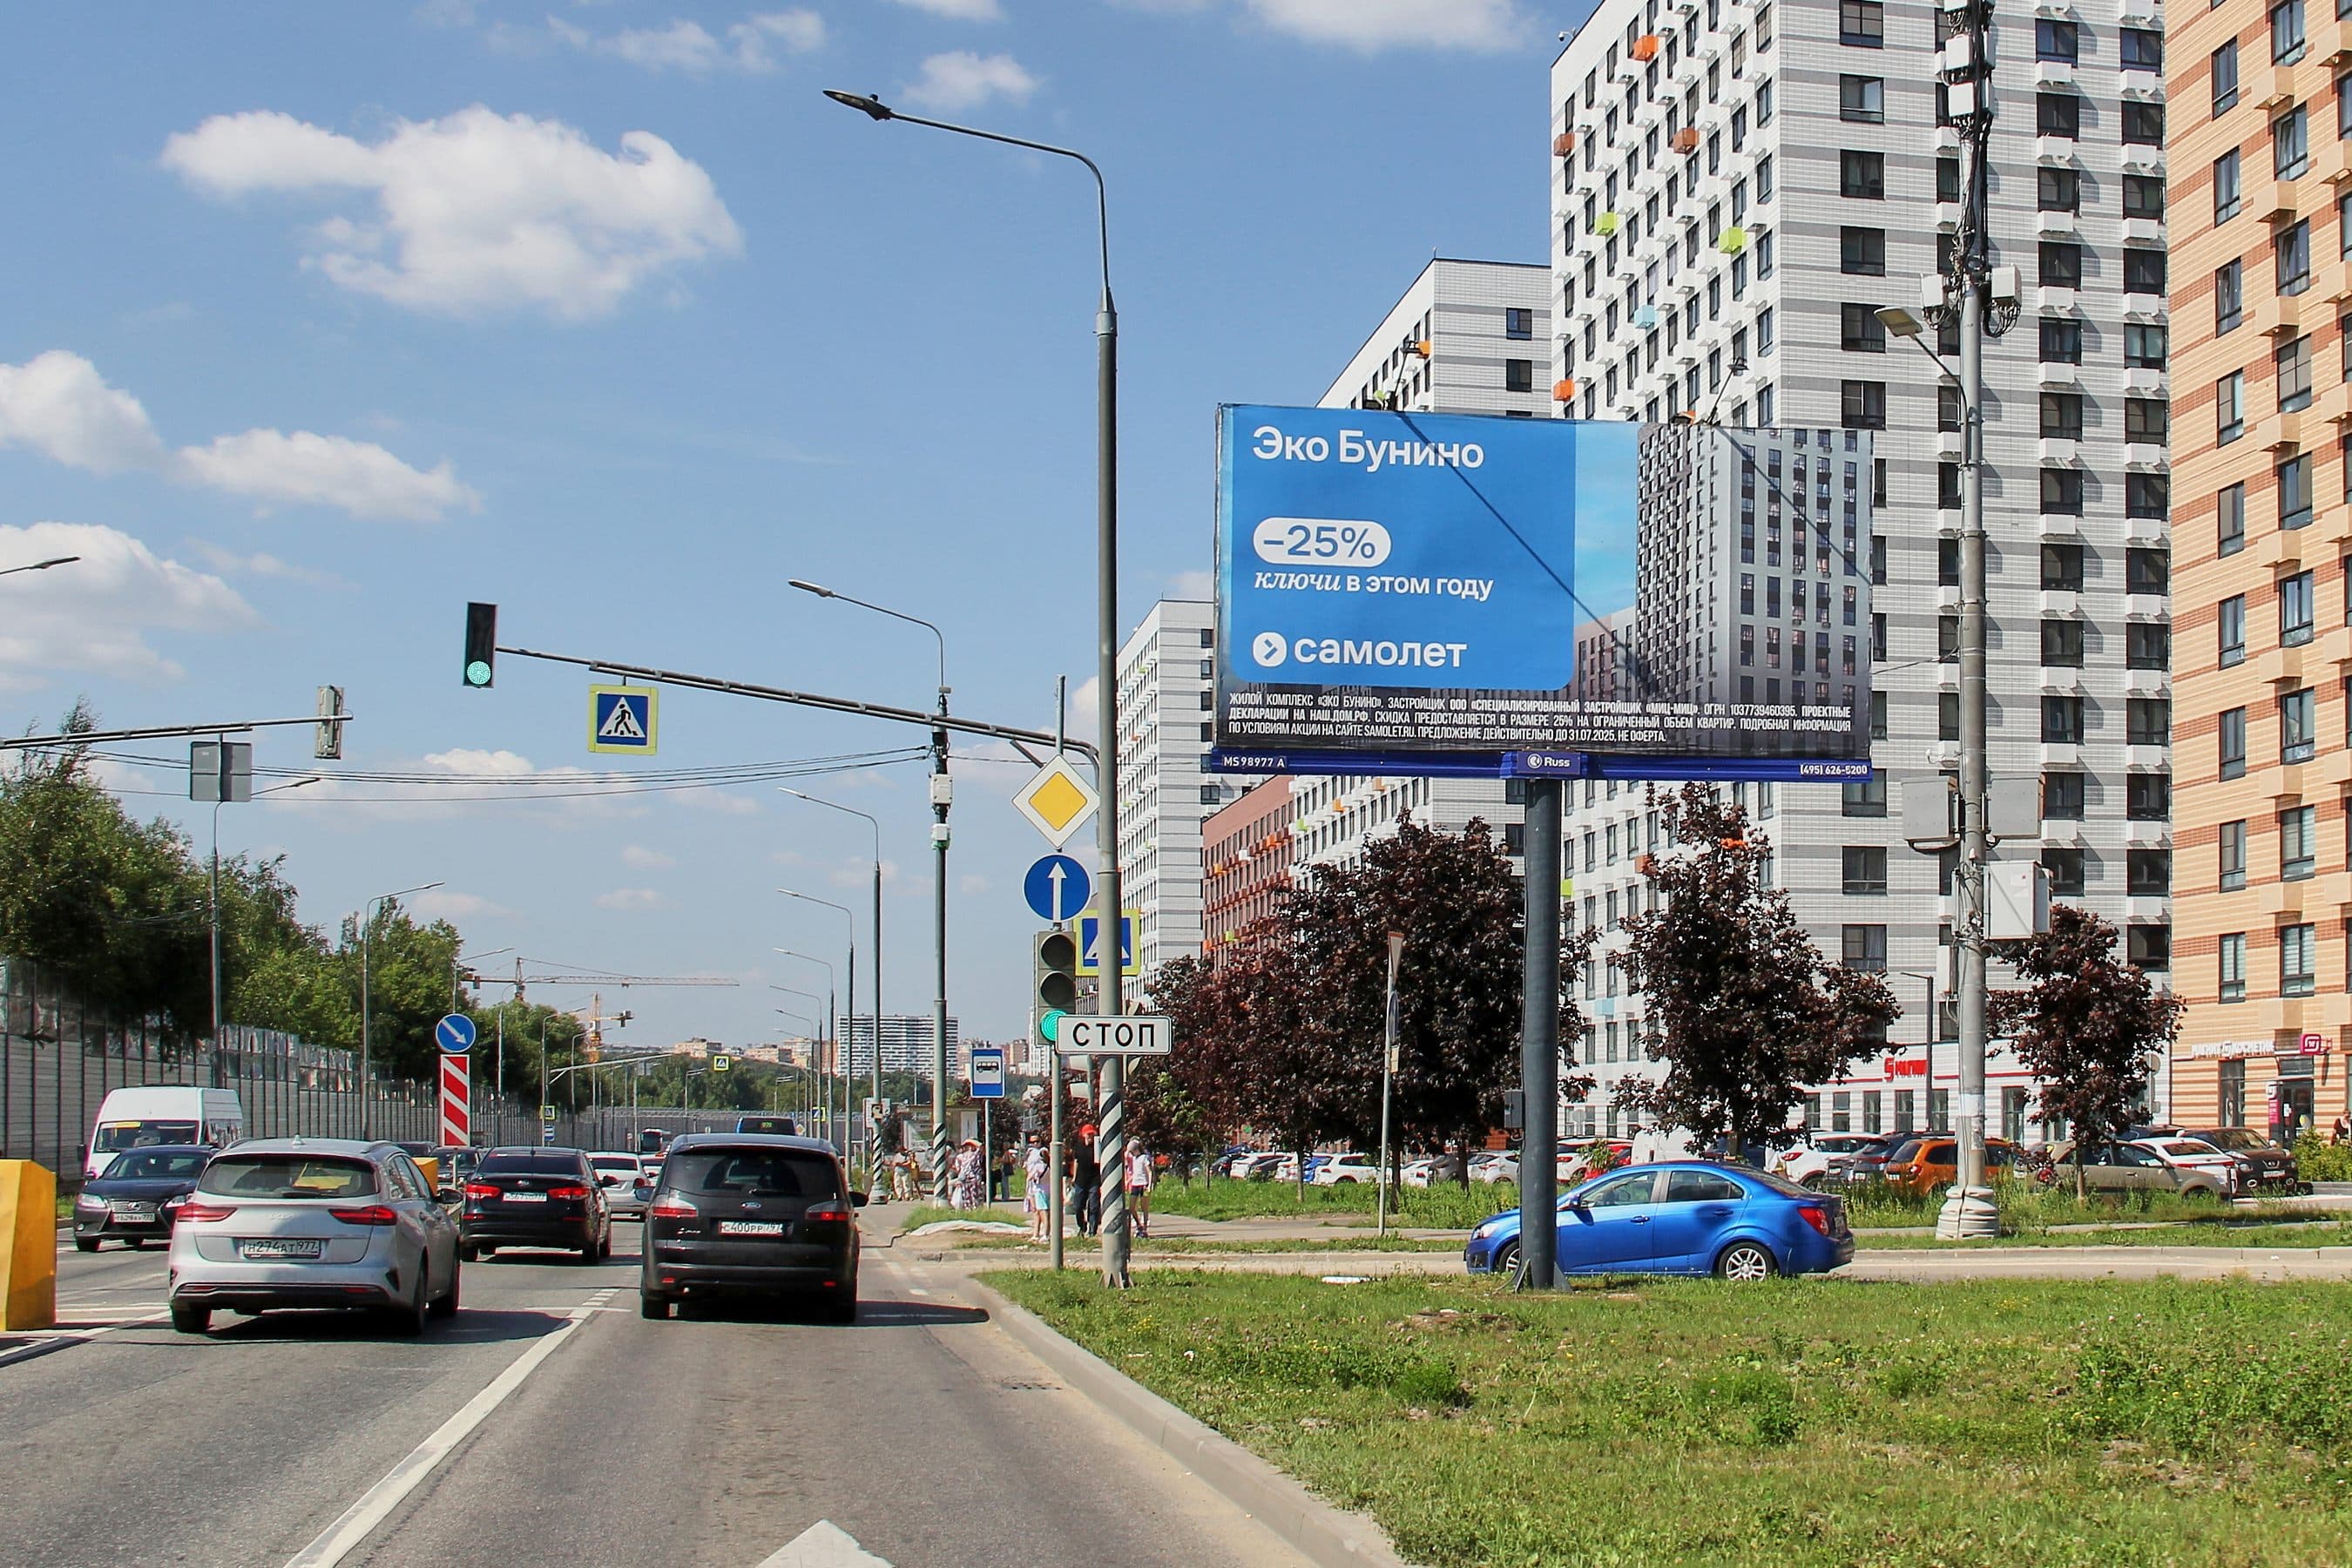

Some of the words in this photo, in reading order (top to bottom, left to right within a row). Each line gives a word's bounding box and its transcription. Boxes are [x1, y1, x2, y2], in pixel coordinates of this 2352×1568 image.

[1253, 425, 1329, 462] Эко
[1339, 429, 1484, 473] Бунино
[1254, 571, 1341, 591] ключи
[1346, 576, 1361, 592] в
[1366, 576, 1430, 594] этом
[1436, 578, 1495, 601] году
[1294, 638, 1468, 668] самолет
[1229, 692, 1262, 706] ЖИЛОЙ
[1266, 693, 1314, 706] КОМПЛЕКС
[1318, 695, 1339, 707] «ЭКО
[1388, 696, 1445, 710] ЗАСТРОЙЩИК
[1450, 699, 1467, 710] ООО
[1471, 698, 1579, 713] «СПЕЦИАЛИЗИРОВАННЫЙ
[1584, 700, 1641, 714] ЗАСТРОЙЩИК
[1704, 704, 1725, 715] ОГРН
[1801, 706, 1851, 718] ПРОЕКТНЫЕ
[1228, 707, 1288, 720] ДЕКЛАРАЦИИ
[1293, 709, 1306, 720] НА
[1310, 709, 1370, 722] НАШ.ДОМ.РФ.
[1375, 711, 1409, 723] СКИДКА
[1414, 712, 1496, 725] ПРЕДОСТАВЛЯЕТСЯ
[1500, 714, 1506, 725] В
[1511, 714, 1549, 726] РАЗМЕРЕ
[1554, 714, 1572, 727] 25%
[1577, 715, 1589, 727] НА
[1593, 714, 1660, 728] ОГРАНИЧЕННЫЙ
[1664, 717, 1693, 729] ОБЪЕМ
[1697, 718, 1736, 729] КВАРТИР.
[1740, 719, 1789, 731] ПОДРОБНАЯ
[1793, 720, 1851, 733] ИНФОРМАЦИЯ
[1228, 722, 1240, 733] ПО
[1242, 722, 1288, 734] УСЛОВИЯМ
[1290, 723, 1321, 736] АКЦИИ
[1322, 724, 1334, 735] НА
[1335, 722, 1362, 736] САЙТЕ
[1364, 725, 1416, 738] SAMOLET.RU.
[1418, 727, 1481, 739] ПРЕДЛОЖЕНИЕ
[1483, 727, 1553, 740] ДЕЙСТВИТЕЛЬНО
[1555, 729, 1567, 741] ДО
[1618, 730, 1628, 740] НЕ
[1630, 729, 1666, 741] ОФЕРТА.
[1277, 758, 1285, 767] A
[1544, 756, 1571, 767] Russ
[1800, 764, 1823, 775] (495)
[1825, 764, 1868, 774] 626-5200
[1072, 1022, 1154, 1046] СТОП
